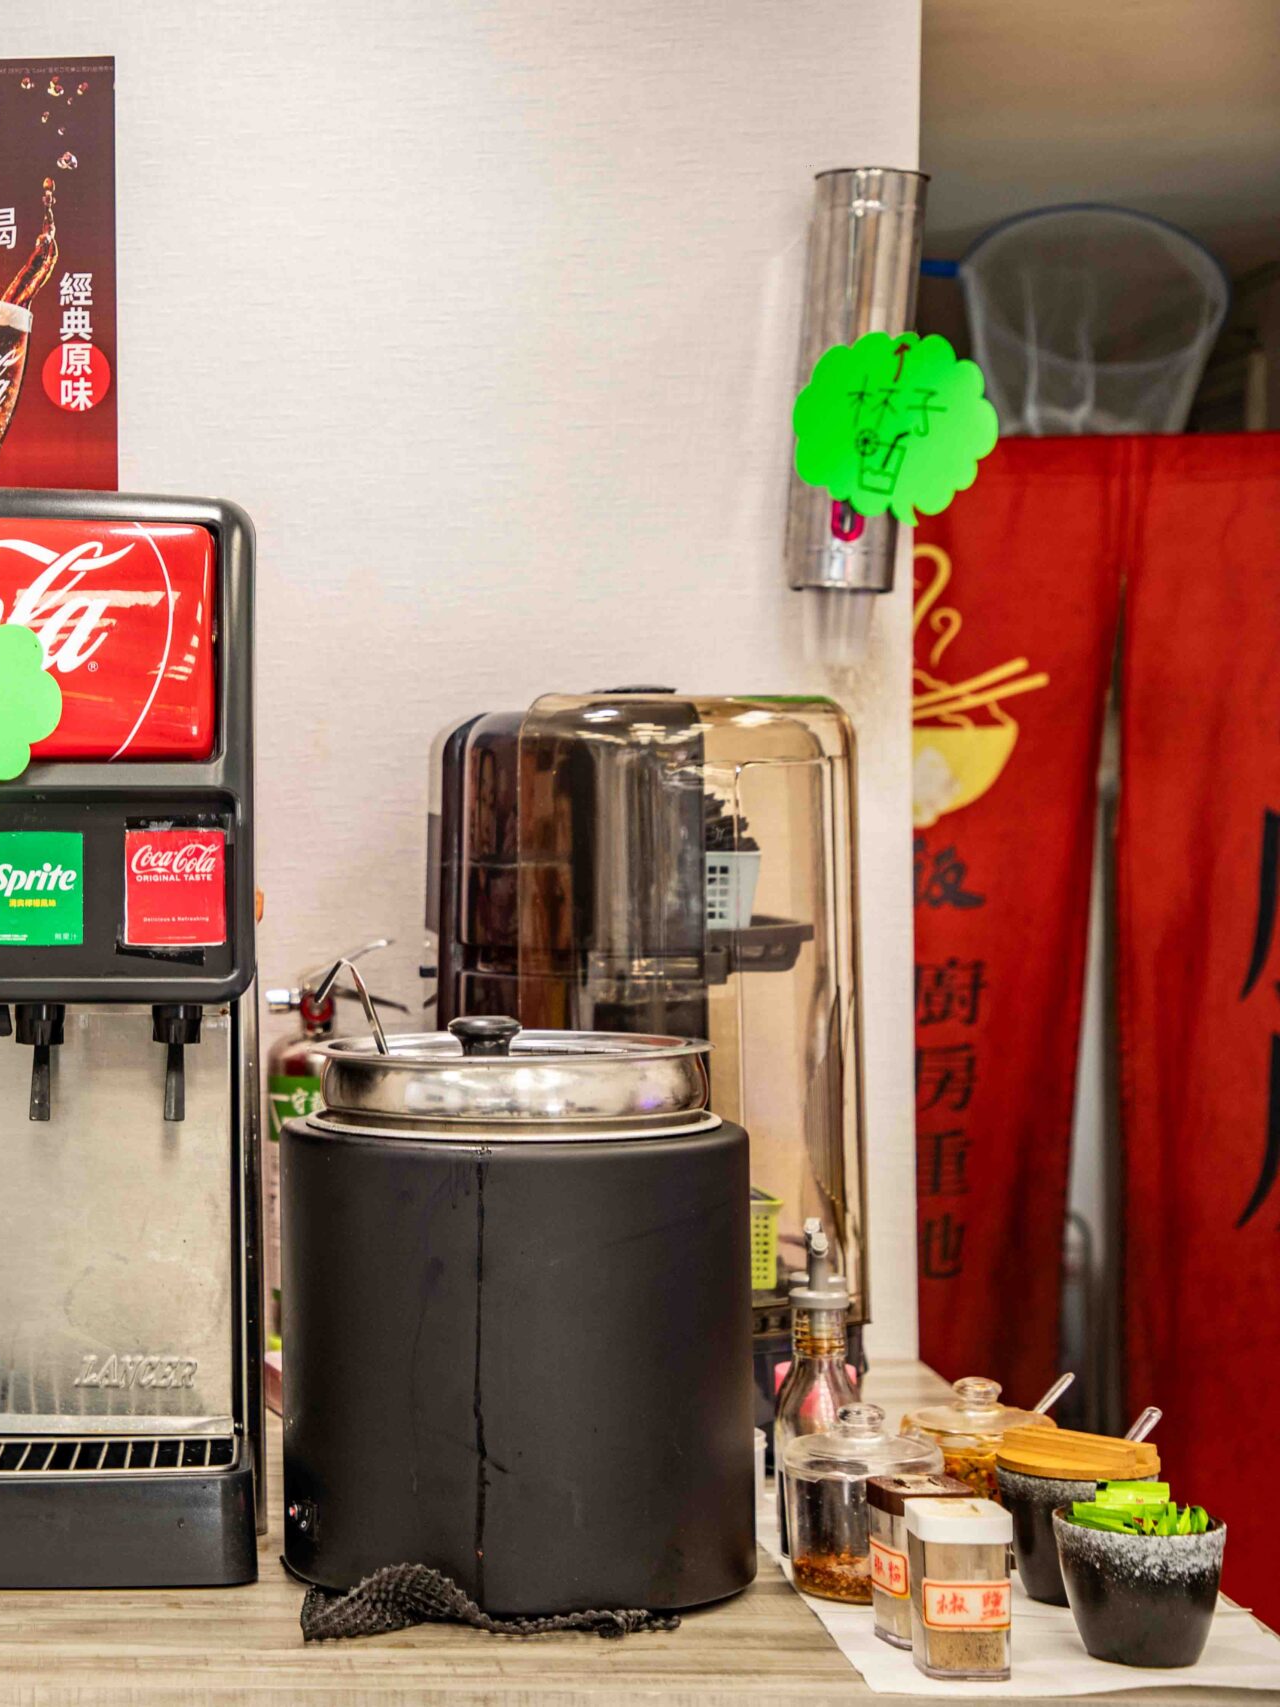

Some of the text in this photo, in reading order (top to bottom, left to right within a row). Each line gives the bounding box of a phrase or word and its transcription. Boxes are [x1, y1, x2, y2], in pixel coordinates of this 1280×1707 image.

[59, 272, 94, 412] 經典原味
[131, 843, 220, 874] Coca-Cola
[136, 874, 181, 882] ORIGINAL
[74, 1354, 198, 1389] LANCER
